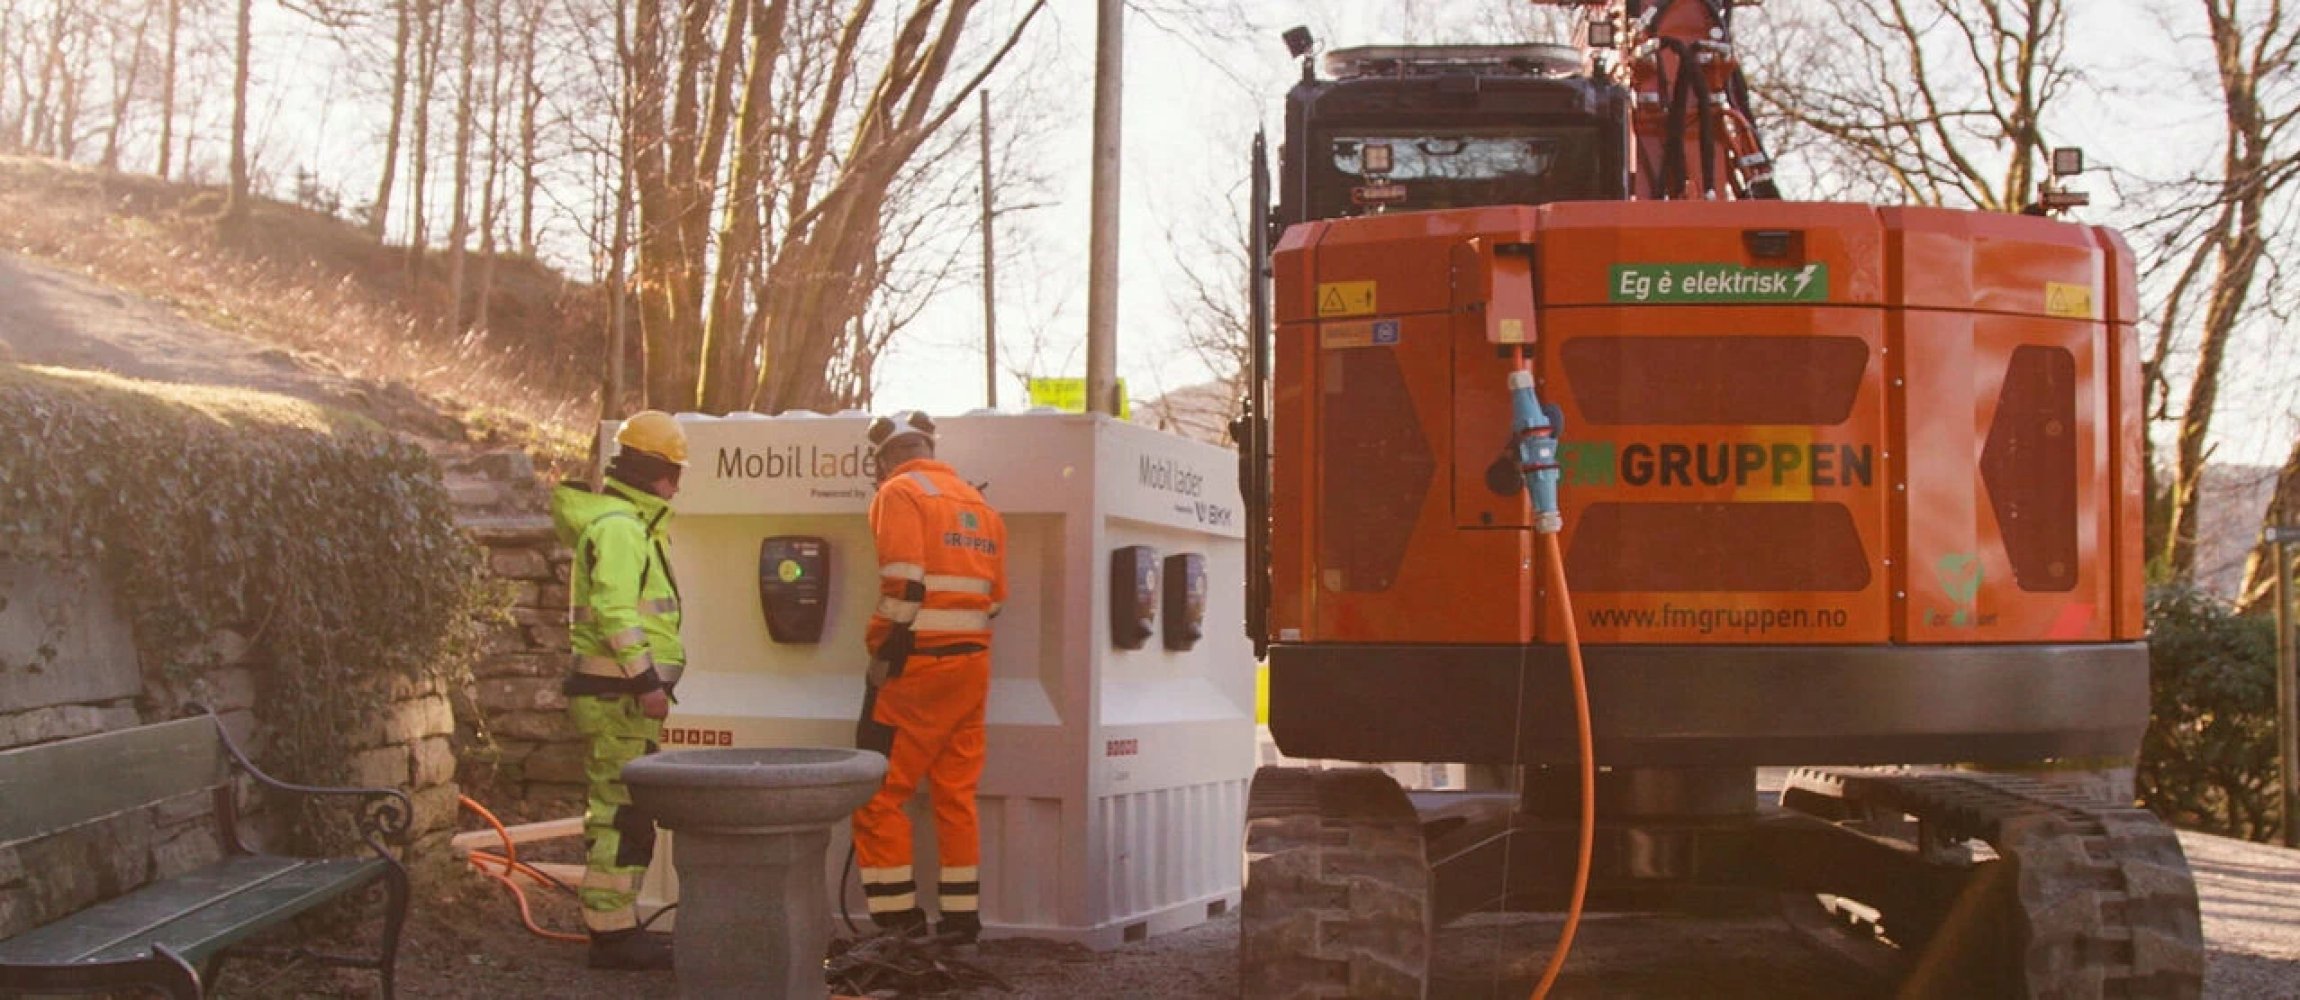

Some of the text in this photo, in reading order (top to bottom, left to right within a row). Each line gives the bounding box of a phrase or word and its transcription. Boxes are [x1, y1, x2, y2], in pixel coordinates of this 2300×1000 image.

[1620, 270, 1650, 300] Eg
[1682, 271, 1788, 293] elektrisk
[716, 446, 878, 479] Mobil lade
[1139, 454, 1203, 498] Mobil lader
[1588, 602, 1848, 634] www.fmgruppen.no
